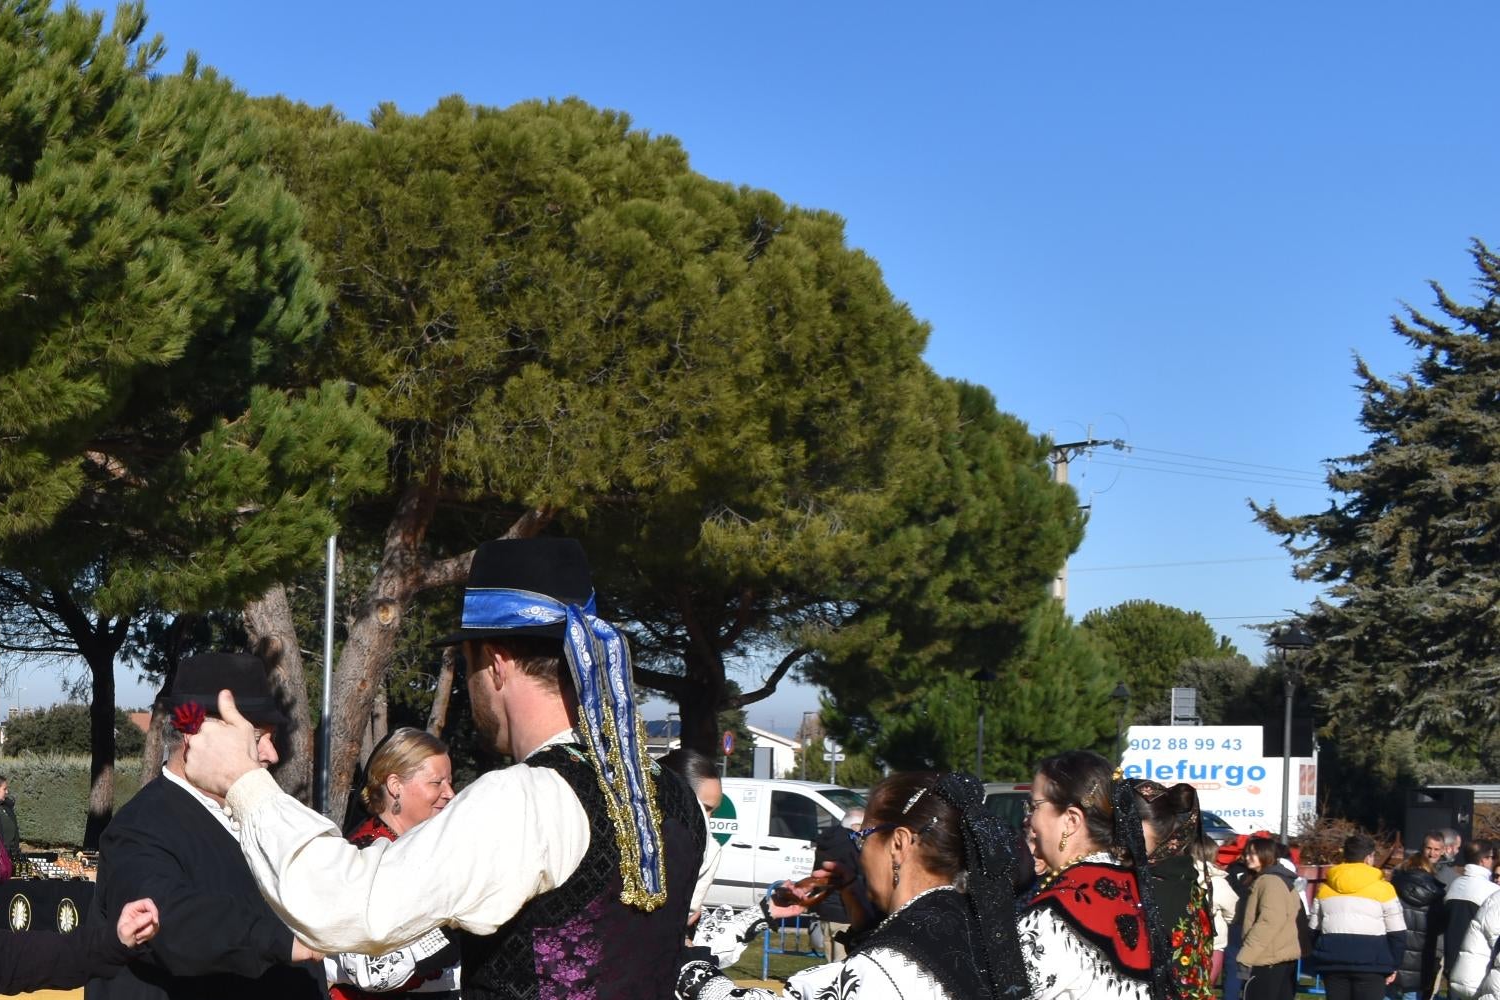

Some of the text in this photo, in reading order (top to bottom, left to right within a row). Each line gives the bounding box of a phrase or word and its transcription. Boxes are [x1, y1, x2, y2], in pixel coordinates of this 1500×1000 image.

[1130, 738, 1242, 750] 902 88 99 43
[1123, 759, 1266, 786] elefurgo
